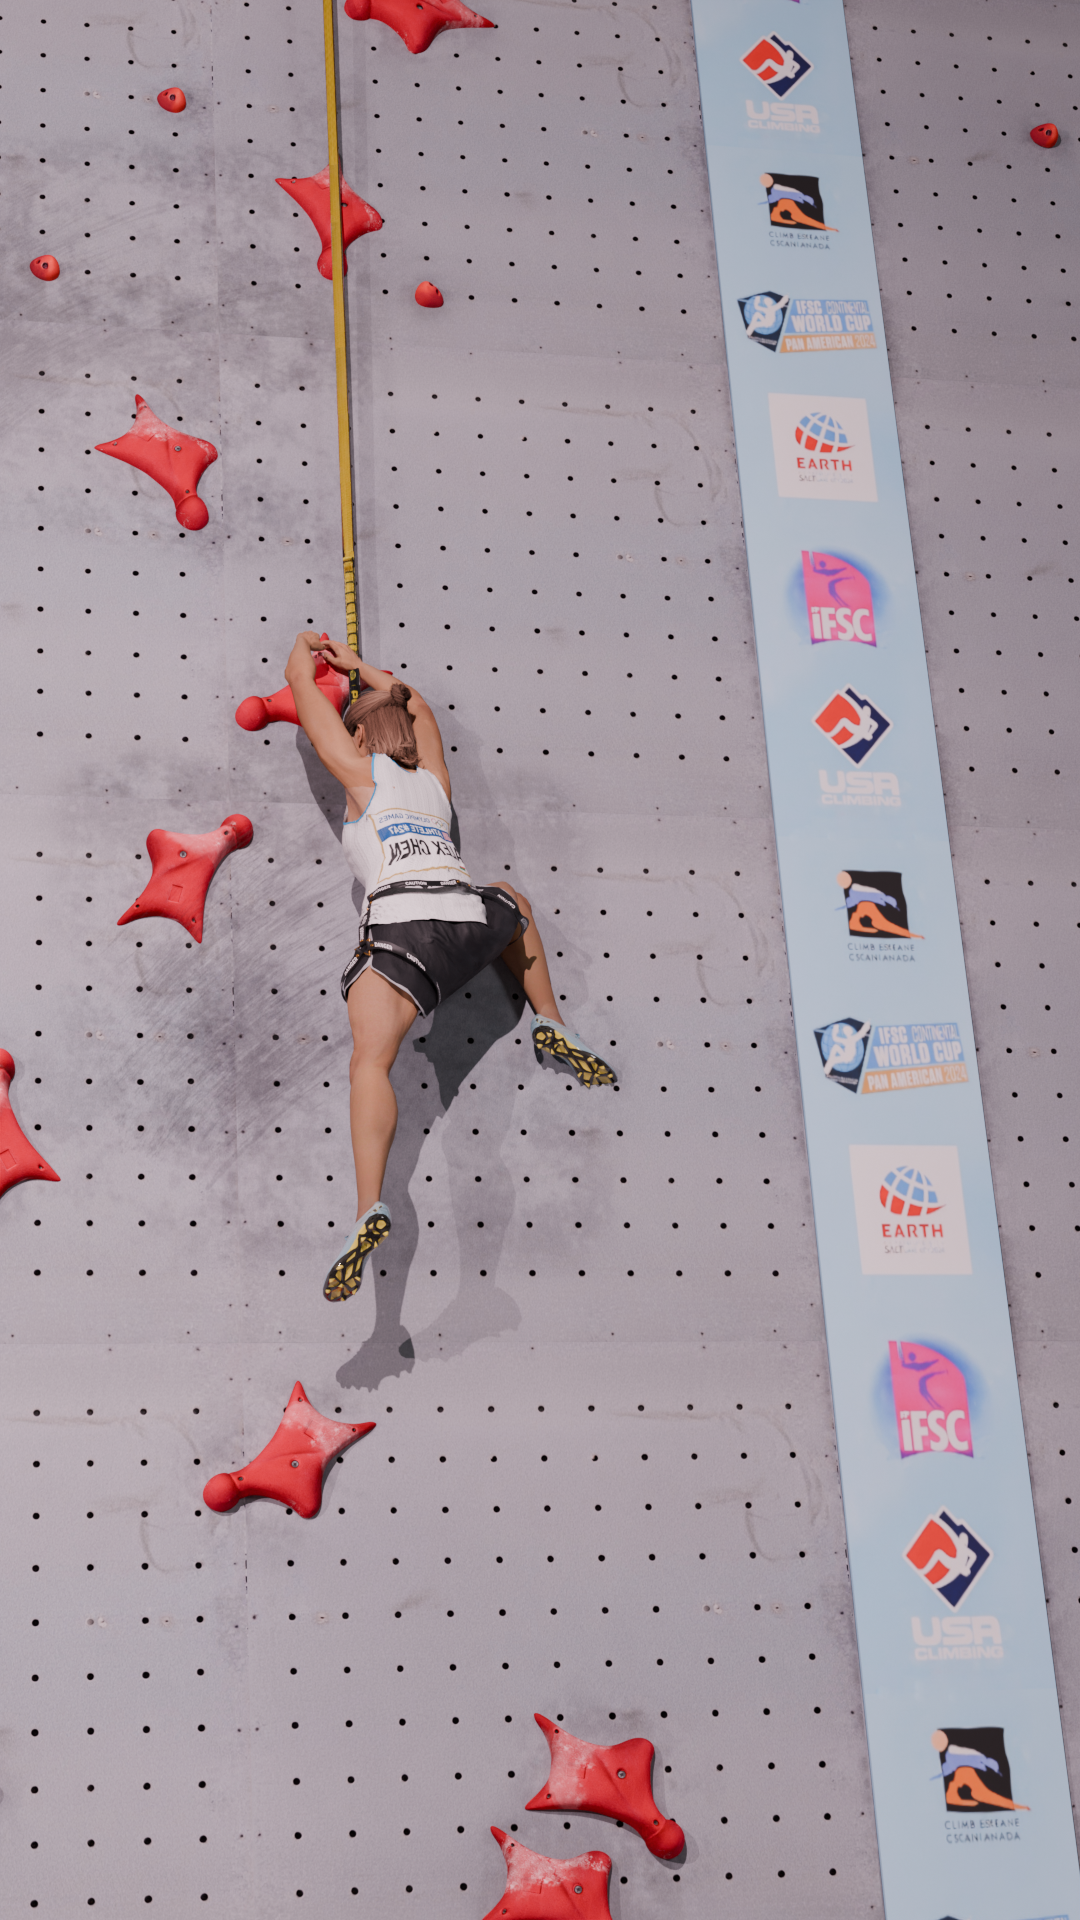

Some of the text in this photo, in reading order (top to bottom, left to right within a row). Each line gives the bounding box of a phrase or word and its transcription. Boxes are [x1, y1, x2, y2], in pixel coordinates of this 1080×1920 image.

[745, 99, 819, 125] USA
[747, 119, 821, 134] CLIMBING
[768, 231, 794, 239] CLIMB
[795, 300, 822, 314] IFSC
[791, 314, 871, 332] WORLD CUP
[785, 337, 805, 351] PAN
[806, 335, 854, 350] AMERICAN
[854, 335, 876, 348] 2024
[797, 457, 852, 471] EARTH
[818, 769, 900, 796] USA
[821, 794, 901, 807] CLIMBING
[847, 943, 875, 951] CLIMB
[878, 1025, 908, 1044] IFSC
[874, 1041, 962, 1067] WORLD CUP
[867, 1074, 889, 1091] PAN
[891, 1069, 943, 1088] AMERICAN
[945, 1065, 967, 1082] 2024
[882, 1223, 944, 1238] EARTH
[911, 1615, 1002, 1646] USA
[914, 1645, 1004, 1661] CLIMBING
[944, 1819, 976, 1830] CLIMB
